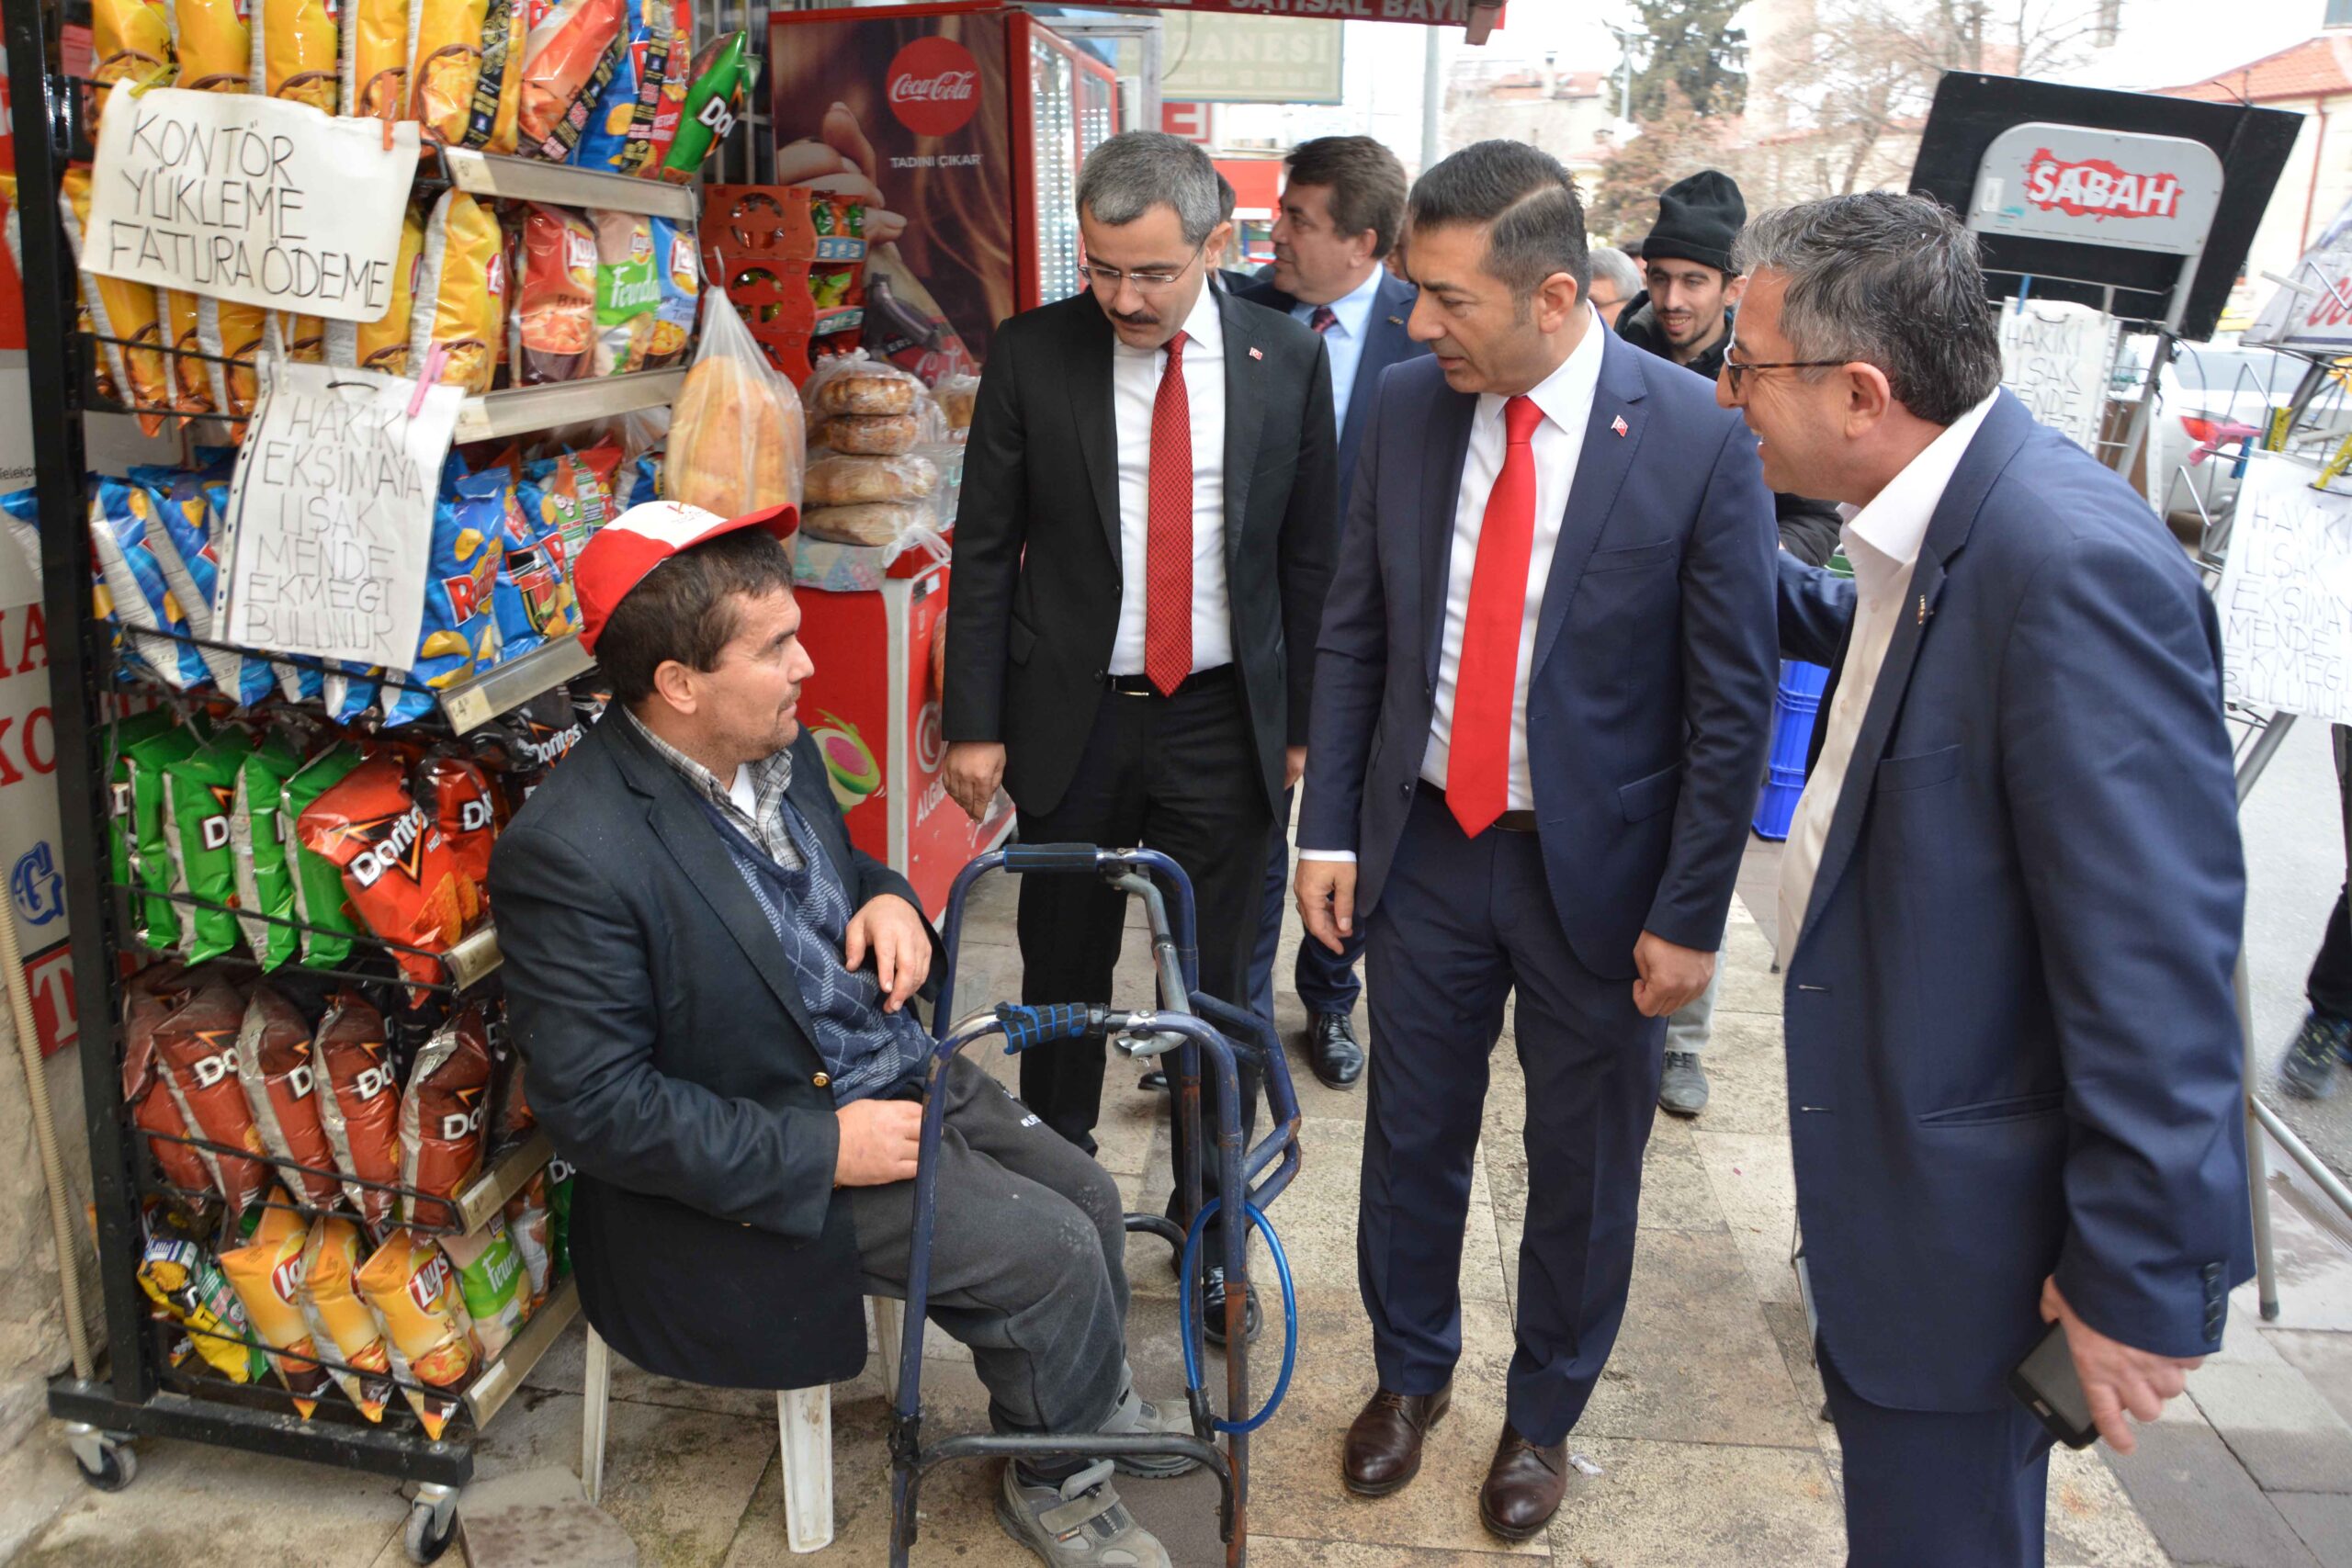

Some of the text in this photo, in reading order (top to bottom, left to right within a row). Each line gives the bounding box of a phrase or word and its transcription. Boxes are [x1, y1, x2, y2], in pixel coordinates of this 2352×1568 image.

[129, 109, 294, 186] KONTÖR
[121, 166, 307, 241] YÜKLEME
[2029, 164, 2179, 216] SABAH
[108, 220, 390, 309] FATURA ÖDEME
[256, 534, 396, 582] MENDE
[243, 603, 394, 658] BULUNUR
